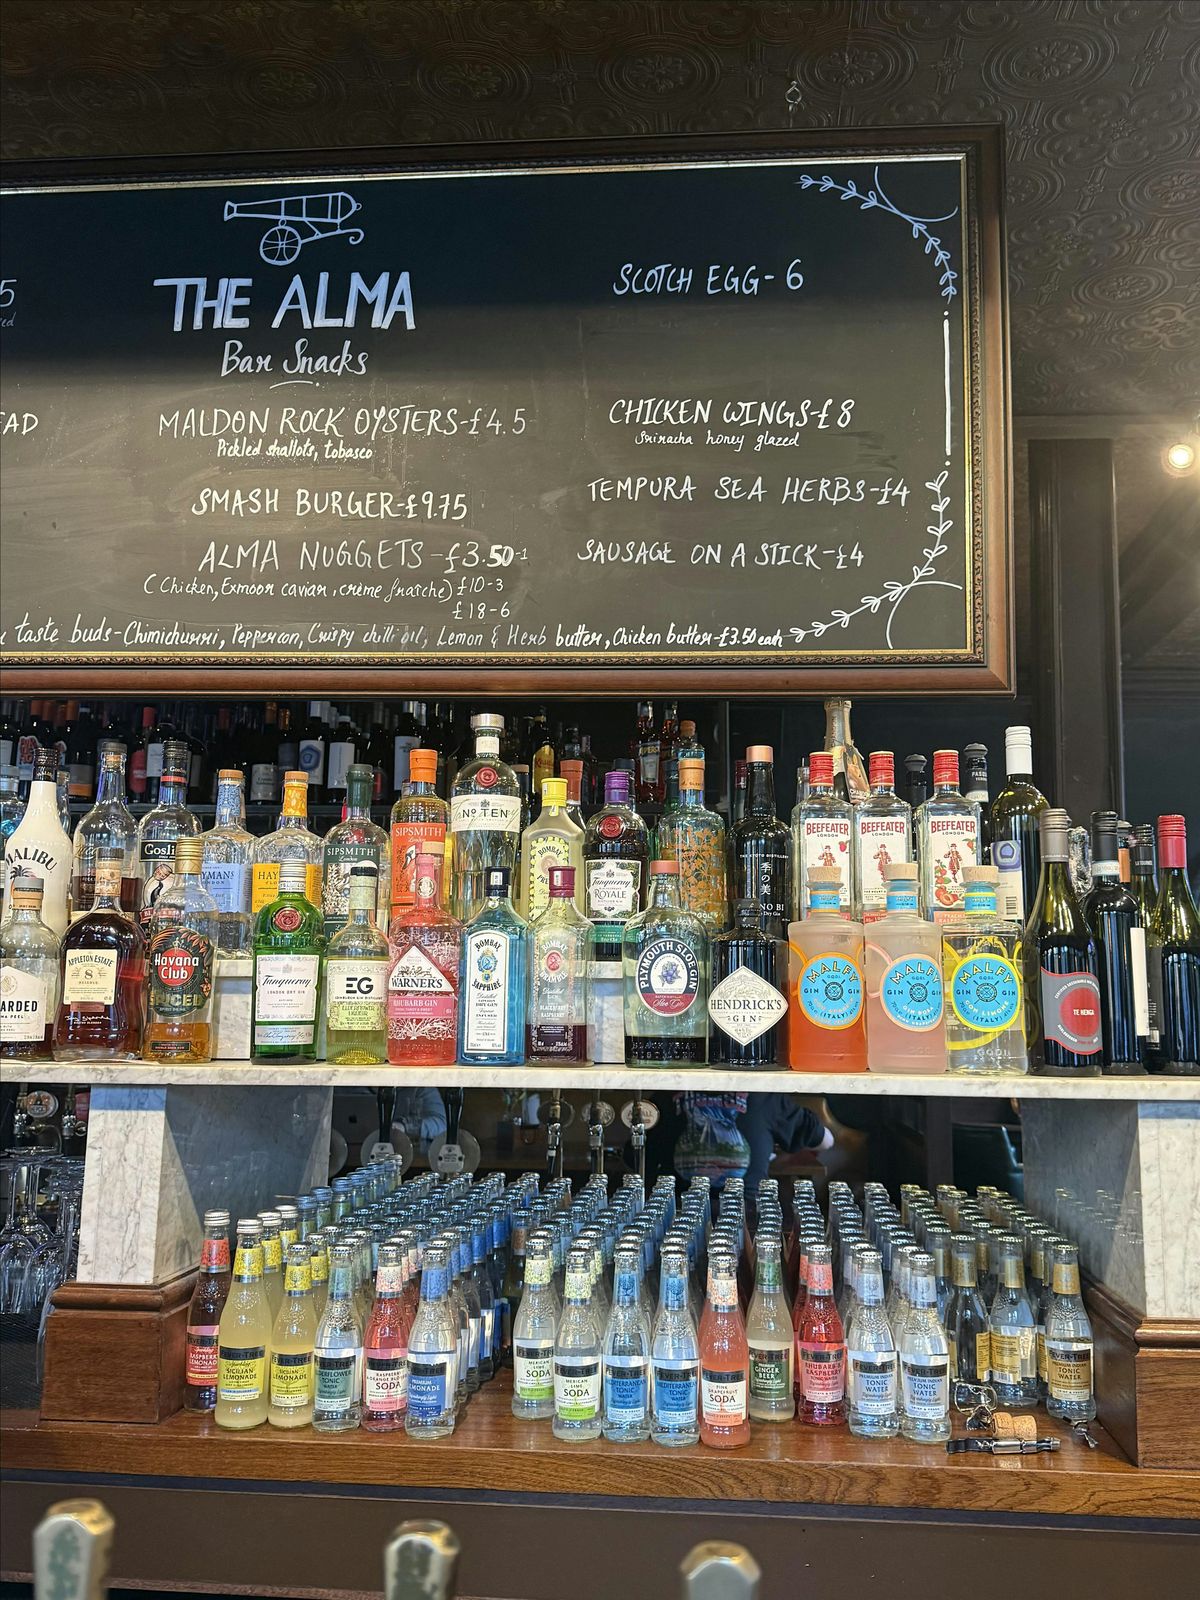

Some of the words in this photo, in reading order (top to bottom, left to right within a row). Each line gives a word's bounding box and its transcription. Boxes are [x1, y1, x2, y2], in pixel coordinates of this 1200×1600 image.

[613, 263, 693, 295] SCOTCH
[786, 258, 804, 291] 6
[154, 277, 252, 332] THE
[271, 272, 416, 330] ALMA
[221, 341, 273, 376] Bar
[282, 339, 369, 375] Snacks
[609, 399, 711, 426] CHICKEN
[159, 408, 268, 439] MALDON
[280, 408, 343, 437] ROCK
[706, 430, 743, 452] honey
[756, 430, 800, 452] glazed
[217, 439, 262, 458] Pickled
[266, 439, 318, 461] shallots,
[324, 441, 373, 460] tobasco
[587, 477, 697, 502] TEMPURA
[714, 479, 767, 502] SEA
[192, 488, 279, 516] SMASH
[197, 539, 279, 573] ALMA
[577, 540, 676, 564] SAUSAGE
[690, 543, 722, 565] ON
[730, 543, 746, 567] A
[221, 578, 275, 598] Exmoor
[15, 612, 59, 645] taste
[308, 623, 355, 648] Crispy
[436, 626, 483, 646] Lemon
[491, 624, 501, 648] &
[507, 625, 546, 646] Herb
[613, 625, 661, 646] Chicken
[757, 628, 783, 647] each
[481, 808, 508, 818] TEN
[395, 827, 442, 837] SIPSMITH
[806, 822, 849, 836] BEEFEATER
[861, 821, 905, 834] BEEFEATER
[931, 820, 975, 834] BEEFEATER
[328, 847, 374, 857] SIPSMITH
[538, 846, 563, 857] BOMBAY
[6, 848, 57, 871] MALIBU
[592, 877, 631, 888] Tanqueray
[761, 861, 772, 896] 季の美
[594, 889, 627, 900] ROYALE
[474, 939, 502, 951] BOMBAY
[541, 940, 568, 953] BOMBAY
[68, 955, 94, 967] APPLETON
[94, 955, 114, 967] ESTATE
[155, 953, 199, 967] Havana
[640, 941, 674, 989] PLYMOUTH
[675, 944, 696, 968] SLOE
[689, 970, 698, 990] GIN
[84, 969, 93, 980] 8
[161, 967, 188, 979] Club
[540, 970, 568, 983] BRAMBLE
[807, 961, 859, 983] MALFY
[890, 962, 940, 985] MALFY
[959, 961, 1013, 985] MALFY
[262, 974, 312, 988] Tanqueray
[345, 977, 374, 994] EG
[391, 978, 443, 988] WARNER'S
[471, 979, 503, 991] SAPPHIRE
[710, 999, 782, 1010] HENDRICK'S
[965, 1000, 978, 1013] CON
[982, 1000, 1009, 1016] LIMONE
[526, 1370, 551, 1378] SODA
[375, 1382, 402, 1390] SODA
[563, 1389, 590, 1397] SODA
[709, 1394, 736, 1403] SODA
